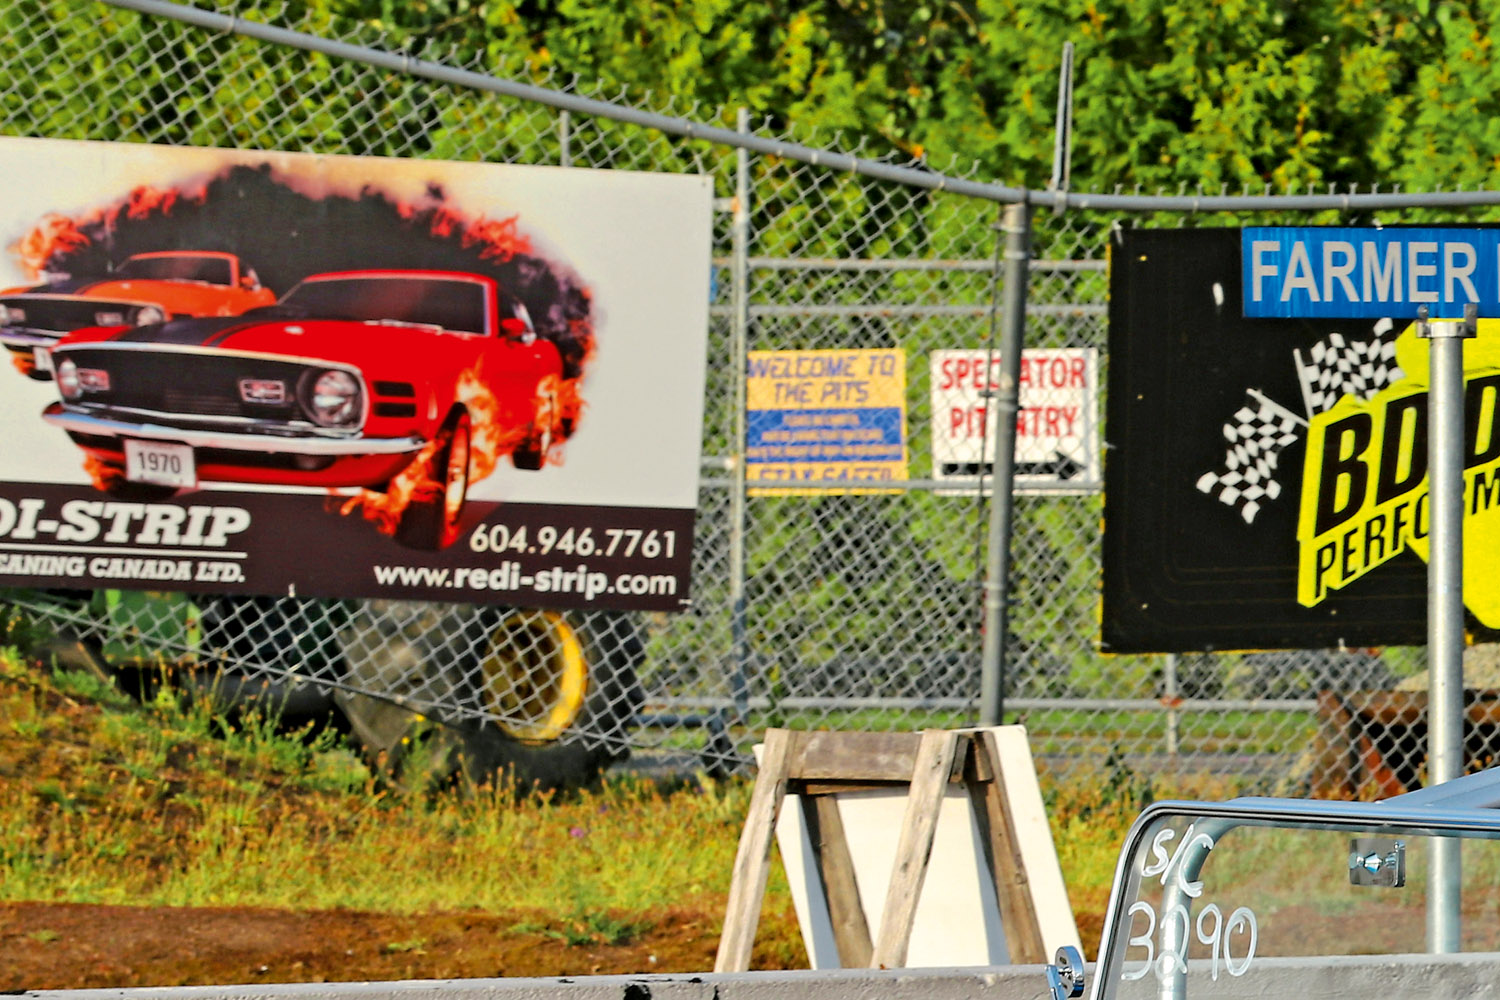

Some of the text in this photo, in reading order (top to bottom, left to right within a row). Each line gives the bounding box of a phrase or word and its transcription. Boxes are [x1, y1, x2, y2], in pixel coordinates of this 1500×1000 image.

[1252, 240, 1480, 303] FARMER
[748, 354, 896, 379] WELCOME TO
[940, 357, 1086, 390] SPECATOR
[774, 381, 870, 403] THE PITS
[951, 407, 987, 438] PIT
[137, 451, 181, 474] 1970
[1314, 393, 1429, 537] BD
[469, 523, 675, 559] 604.946.7761
[89, 557, 193, 580] CANADA
[195, 561, 246, 583] LTD.
[373, 562, 677, 601] www.redi-strip.com
[1142, 824, 1214, 898] S/C
[1121, 901, 1257, 982] 3290
